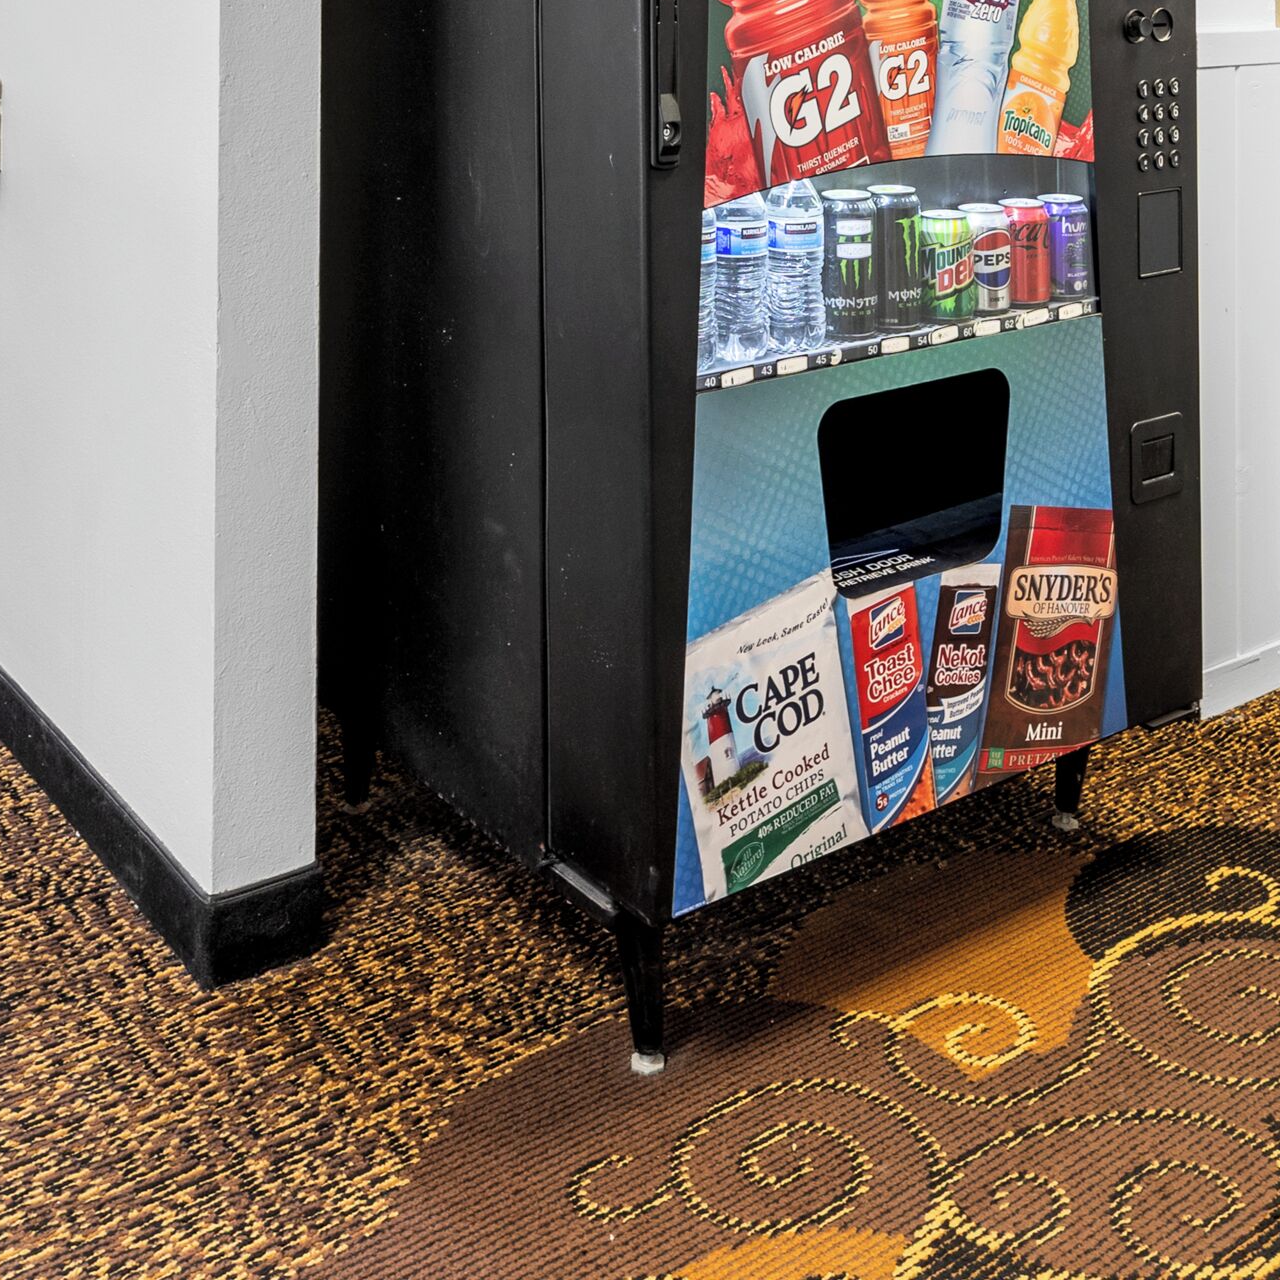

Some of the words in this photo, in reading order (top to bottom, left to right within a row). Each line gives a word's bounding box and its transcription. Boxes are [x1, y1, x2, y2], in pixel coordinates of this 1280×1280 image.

[971, 2, 1002, 23] zero
[764, 55, 792, 77] LOW
[794, 31, 845, 65] CALORIE
[880, 44, 896, 54] LOW
[897, 37, 927, 51] CALORIE
[879, 48, 930, 101] G2
[1020, 75, 1044, 91] ORANGE
[1043, 84, 1057, 97] JUICE
[1142, 84, 1147, 96] 1
[1158, 83, 1164, 94] 2
[1173, 81, 1179, 93] 3
[770, 53, 862, 148] G2
[1142, 108, 1148, 120] 4
[1158, 107, 1163, 119] 5
[1173, 105, 1179, 117] 6
[1004, 110, 1052, 148] Tropicana
[1144, 132, 1148, 145] 7
[1158, 131, 1163, 143] 8
[1174, 129, 1179, 142] 9
[1005, 135, 1023, 150] 100%
[797, 155, 822, 173] THIRST
[823, 137, 860, 162] QUENCHER
[1159, 155, 1163, 168] 0
[974, 251, 1010, 266] PEPS
[888, 287, 921, 301] MONS
[1083, 303, 1092, 313] 64
[963, 327, 972, 337] 60
[1005, 320, 1014, 329] 62
[868, 345, 878, 355] 50
[917, 336, 927, 345] 54
[761, 365, 772, 375] 43
[816, 355, 826, 365] 45
[705, 376, 716, 387] 40
[832, 567, 866, 581] USH
[865, 554, 914, 571] DOOR
[838, 568, 897, 588] RETRIEVE
[896, 556, 936, 571] DRINK
[1014, 573, 1112, 605] SNYDER'S
[950, 599, 987, 628] Lance
[1033, 603, 1045, 614] OF
[1046, 602, 1090, 614] HANOVER
[737, 642, 755, 654] New
[756, 632, 779, 648] Look,
[781, 621, 804, 638] Same
[806, 598, 829, 624] Taste!
[870, 601, 904, 646] Lance
[864, 643, 914, 681] Toast
[937, 644, 985, 668] Nekot
[867, 665, 915, 703] Chee
[935, 668, 981, 686] Cookies
[736, 652, 820, 724] CAPE
[883, 686, 908, 703] Crackers
[754, 689, 824, 753] COD
[1025, 721, 1063, 741] Mini
[870, 726, 910, 760] Peanut
[933, 744, 957, 759] tter
[872, 746, 909, 777] Butter
[1009, 751, 1063, 766] PRETZE
[716, 786, 768, 827] Kettle
[772, 743, 830, 790] Cooked
[730, 796, 782, 837] POTATO
[785, 769, 825, 802] CHIPS
[757, 823, 773, 839] 40%
[774, 794, 818, 829] REDUCED
[819, 783, 836, 800] FAT
[790, 823, 848, 870] Original
